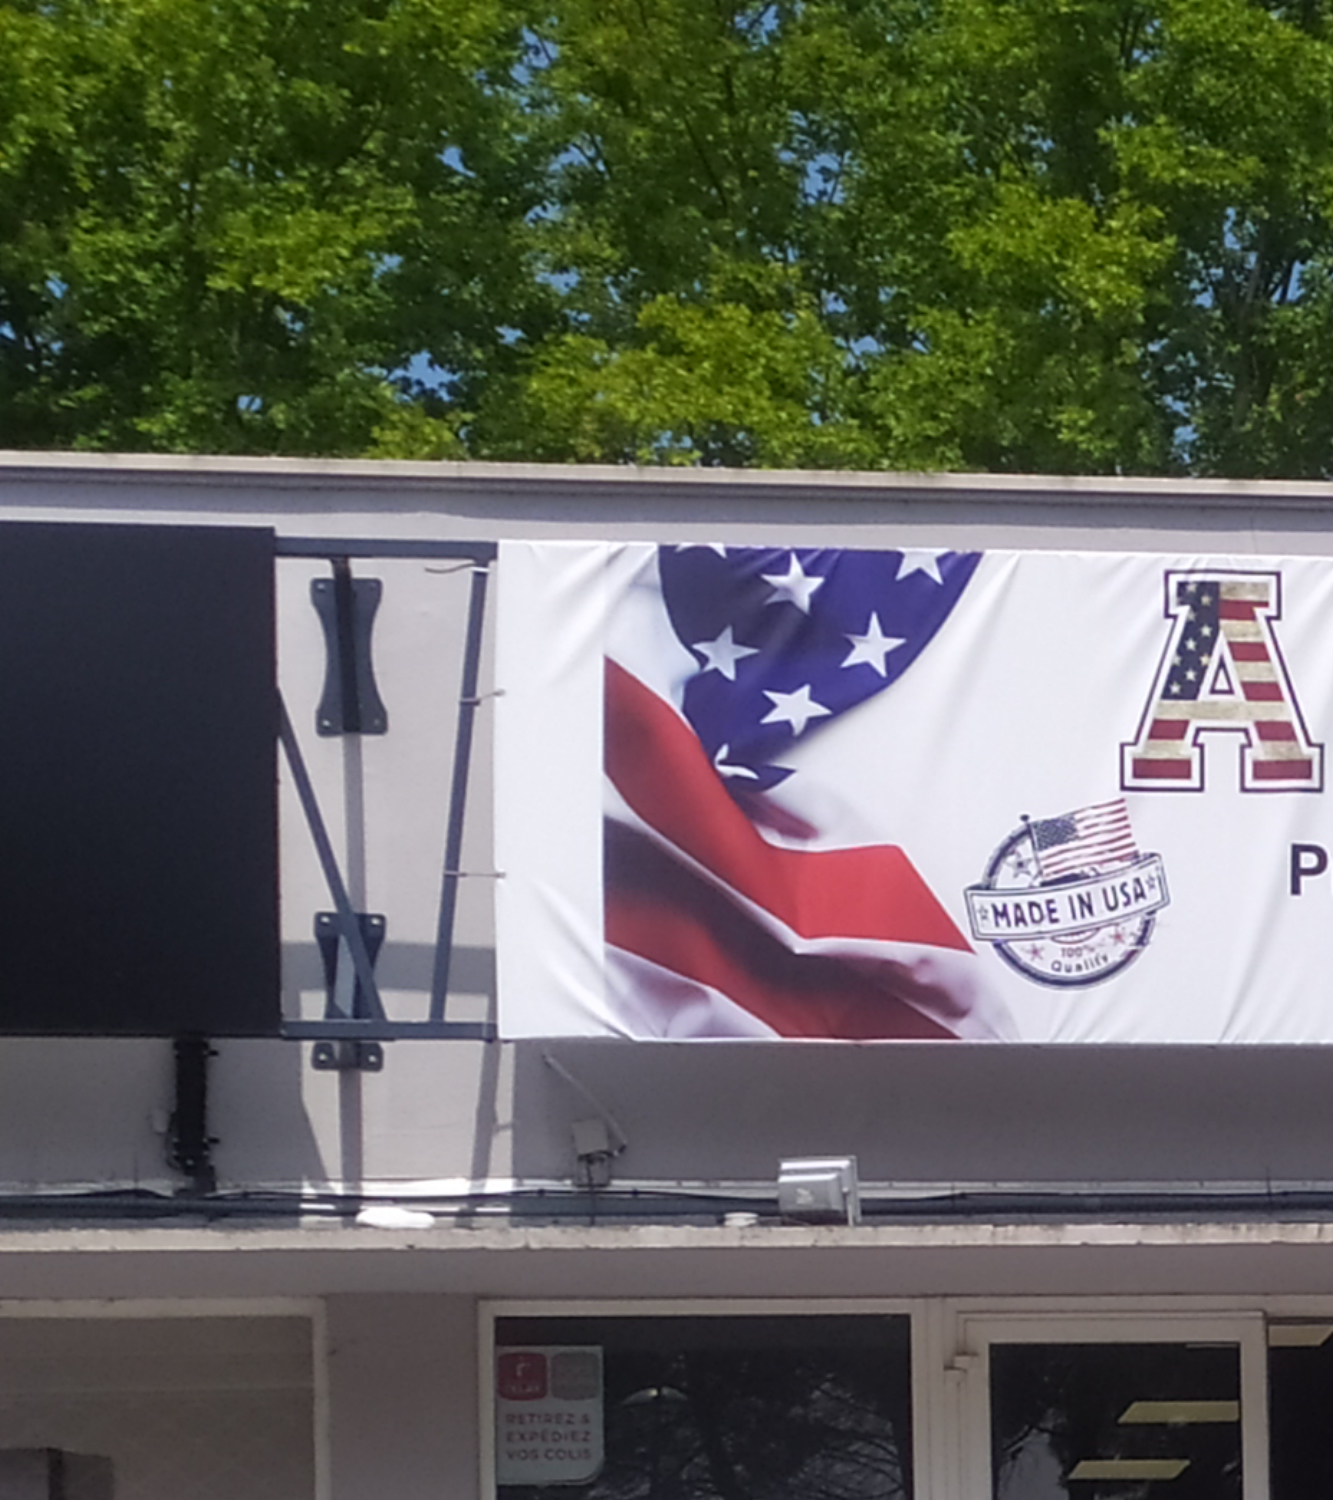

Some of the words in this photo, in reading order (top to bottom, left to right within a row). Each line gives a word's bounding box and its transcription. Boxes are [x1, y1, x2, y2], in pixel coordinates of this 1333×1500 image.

[991, 899, 1059, 929] MADE
[1068, 891, 1094, 920] IN
[1102, 877, 1147, 912] USA
